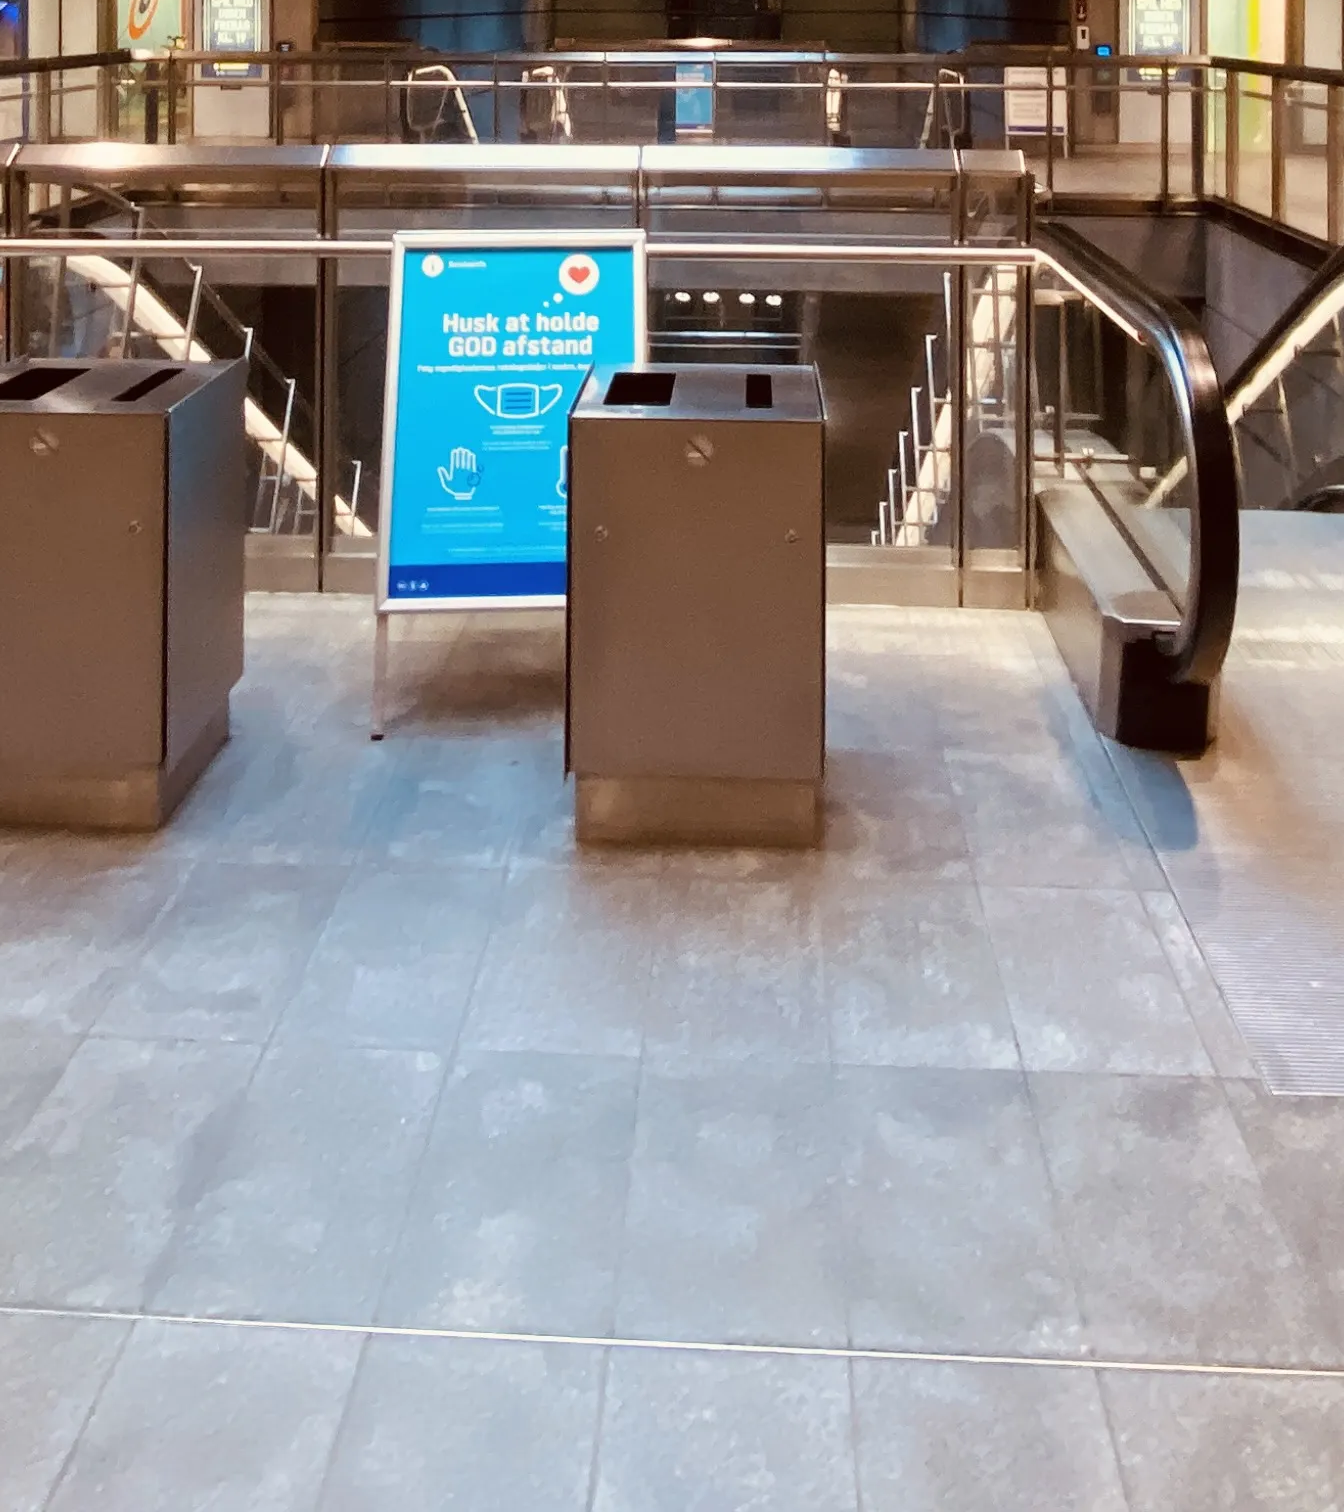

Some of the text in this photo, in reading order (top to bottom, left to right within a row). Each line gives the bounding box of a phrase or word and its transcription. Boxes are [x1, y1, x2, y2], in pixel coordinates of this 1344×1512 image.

[442, 312, 601, 334] Husk at holde
[448, 335, 594, 358] GOD afstand
